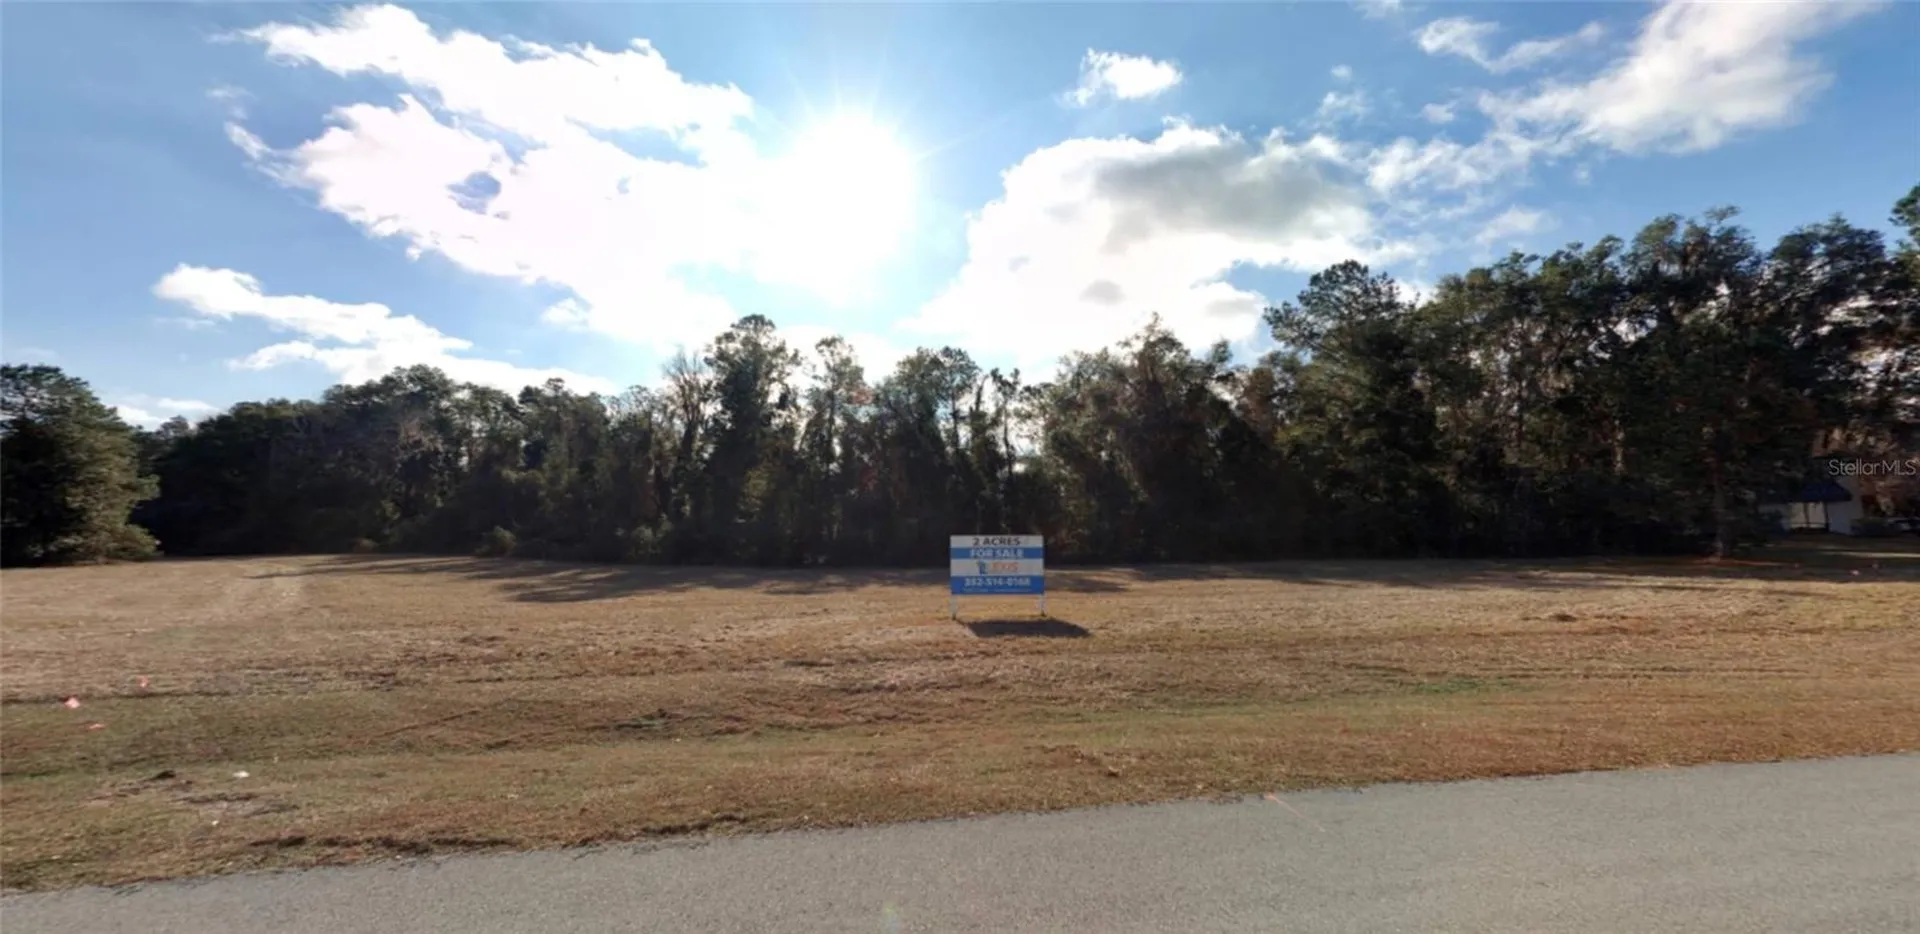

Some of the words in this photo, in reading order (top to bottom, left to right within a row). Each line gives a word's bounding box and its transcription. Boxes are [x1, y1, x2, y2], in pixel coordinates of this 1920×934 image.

[972, 537, 980, 546] 2
[982, 537, 1021, 546] ACRES
[970, 548, 993, 558] FOR
[995, 548, 1024, 558] SALE
